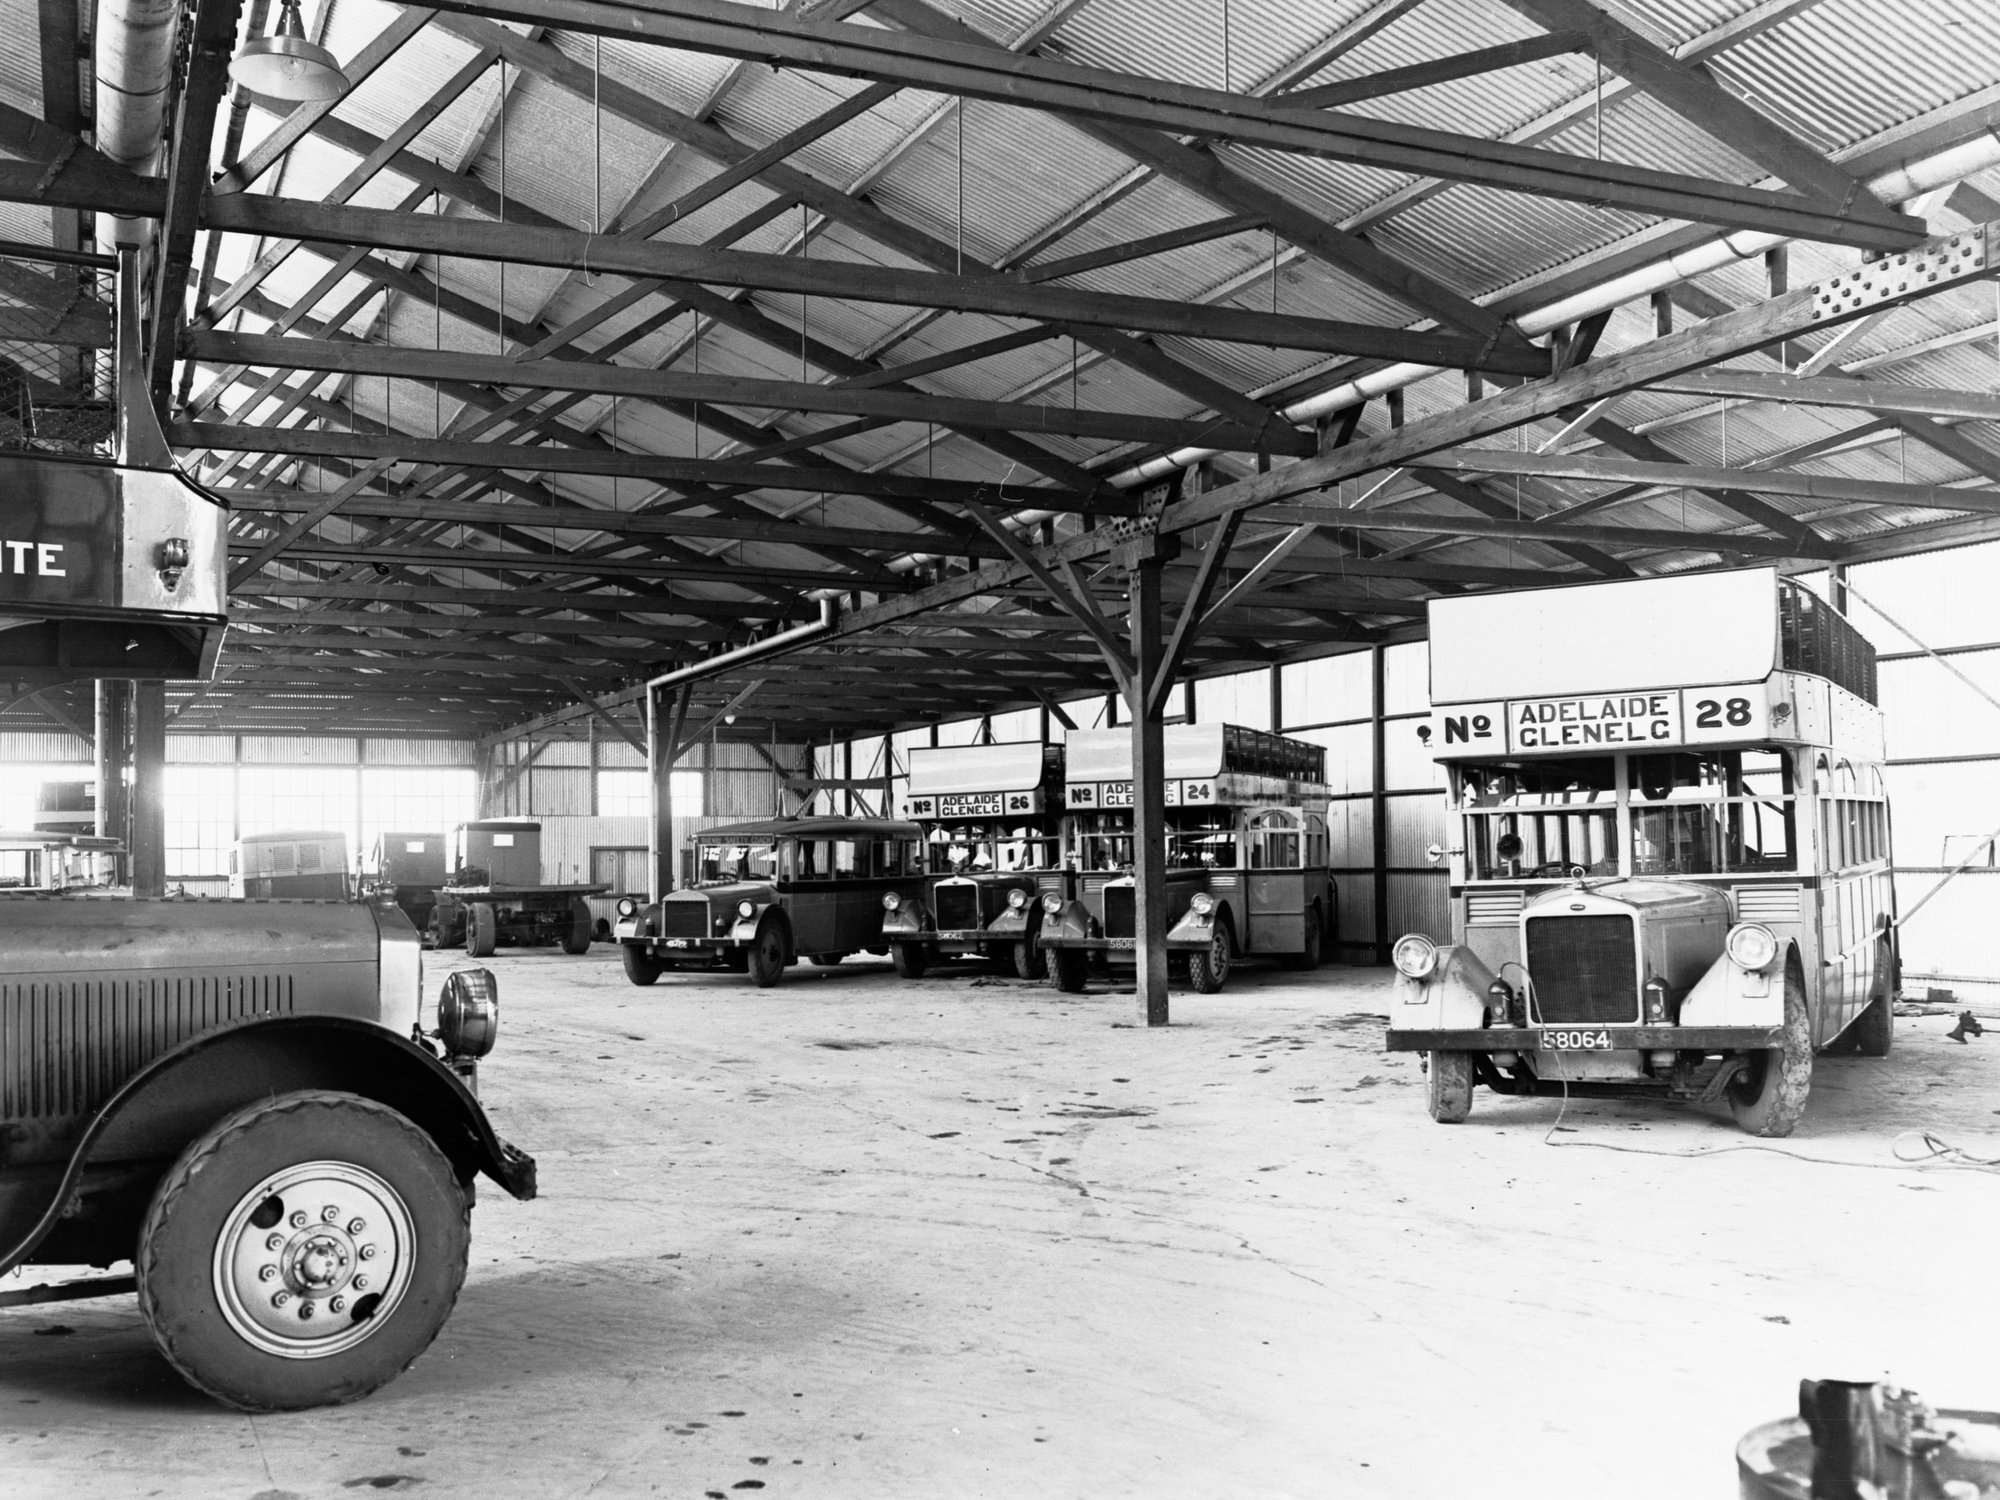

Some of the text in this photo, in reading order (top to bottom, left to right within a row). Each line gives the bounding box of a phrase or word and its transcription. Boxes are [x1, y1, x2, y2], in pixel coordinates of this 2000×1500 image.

[0, 540, 66, 577] TE
[1519, 696, 1669, 724] ADELAIDE
[1696, 697, 1752, 728] 28
[1519, 720, 1670, 747] GLENELG
[1106, 781, 1174, 794] ADEE
[1188, 784, 1210, 799] 24
[942, 794, 1000, 806] ADELAIDE
[1010, 795, 1029, 810] 26
[1106, 793, 1174, 805] GLEG
[942, 804, 1000, 816] GLENELG
[1543, 1031, 1609, 1049] 58064
